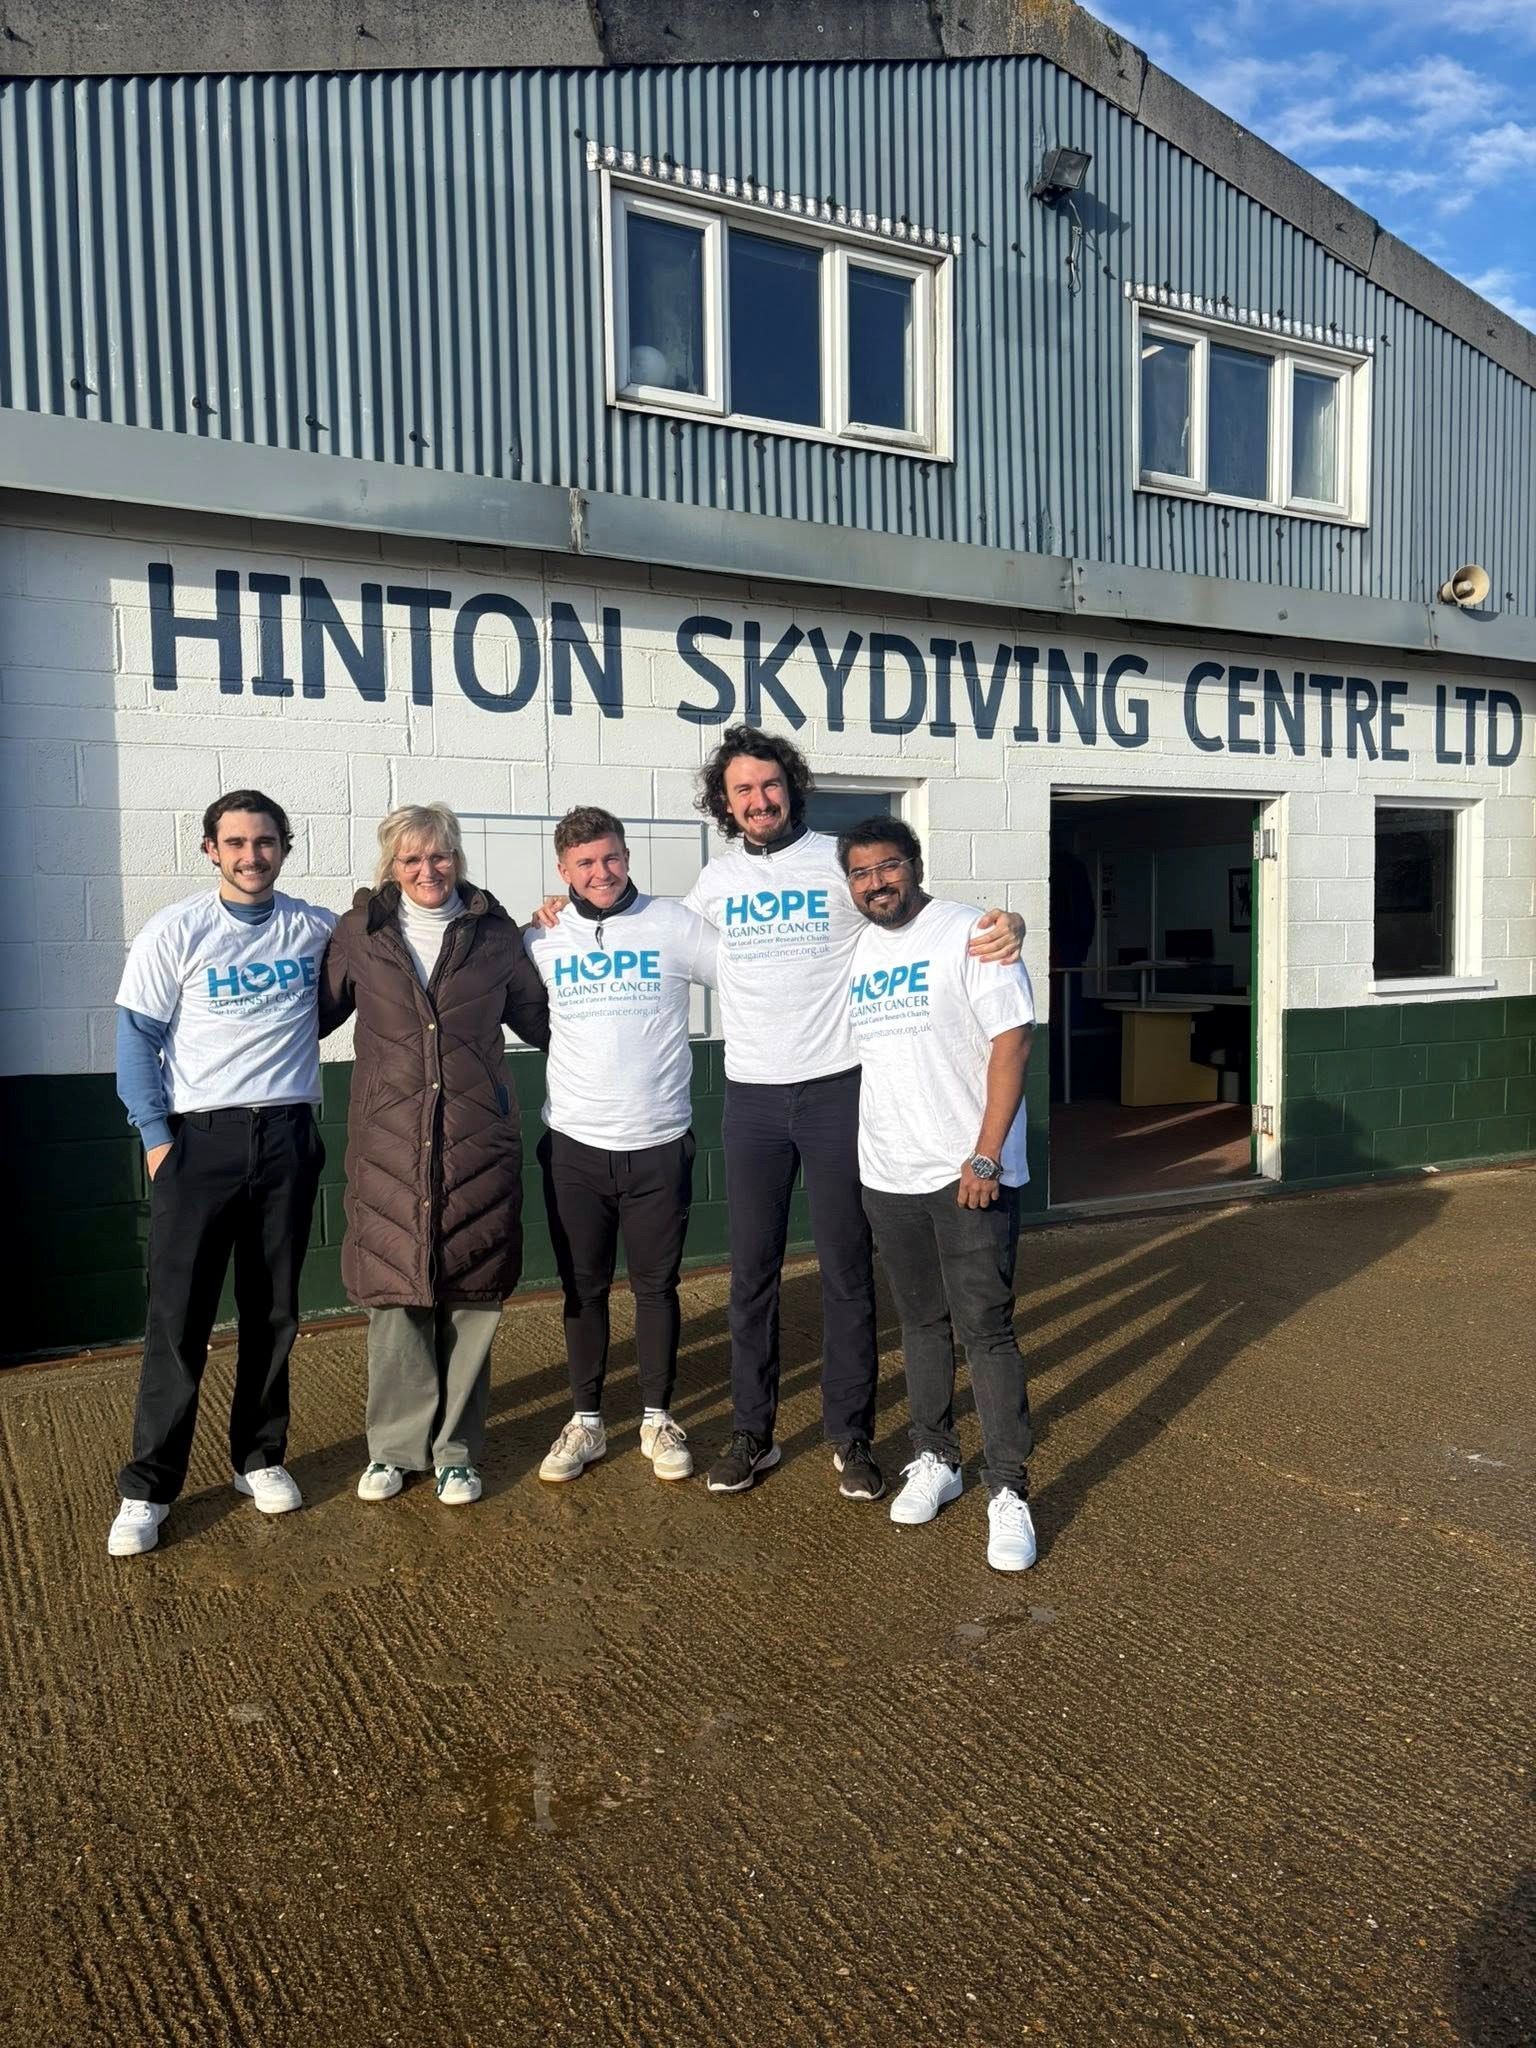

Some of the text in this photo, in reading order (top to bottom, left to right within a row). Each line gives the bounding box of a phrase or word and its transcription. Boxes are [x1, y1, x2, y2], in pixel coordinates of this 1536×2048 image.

[148, 562, 1523, 767] HINTON SKYDIVING CENTRE LTD
[726, 890, 829, 926] HOPE
[728, 921, 830, 938] AGAINST CANCER
[738, 938, 752, 946] Local
[752, 937, 773, 945] Cancer
[207, 956, 316, 997] HOPE
[555, 951, 661, 986] HOPE
[557, 982, 661, 999] AGAINST CANCER
[850, 960, 930, 1006] HOPE
[276, 989, 315, 1003] CANC
[850, 995, 929, 1017] GAINST CANCER
[907, 1009, 930, 1018] Charity
